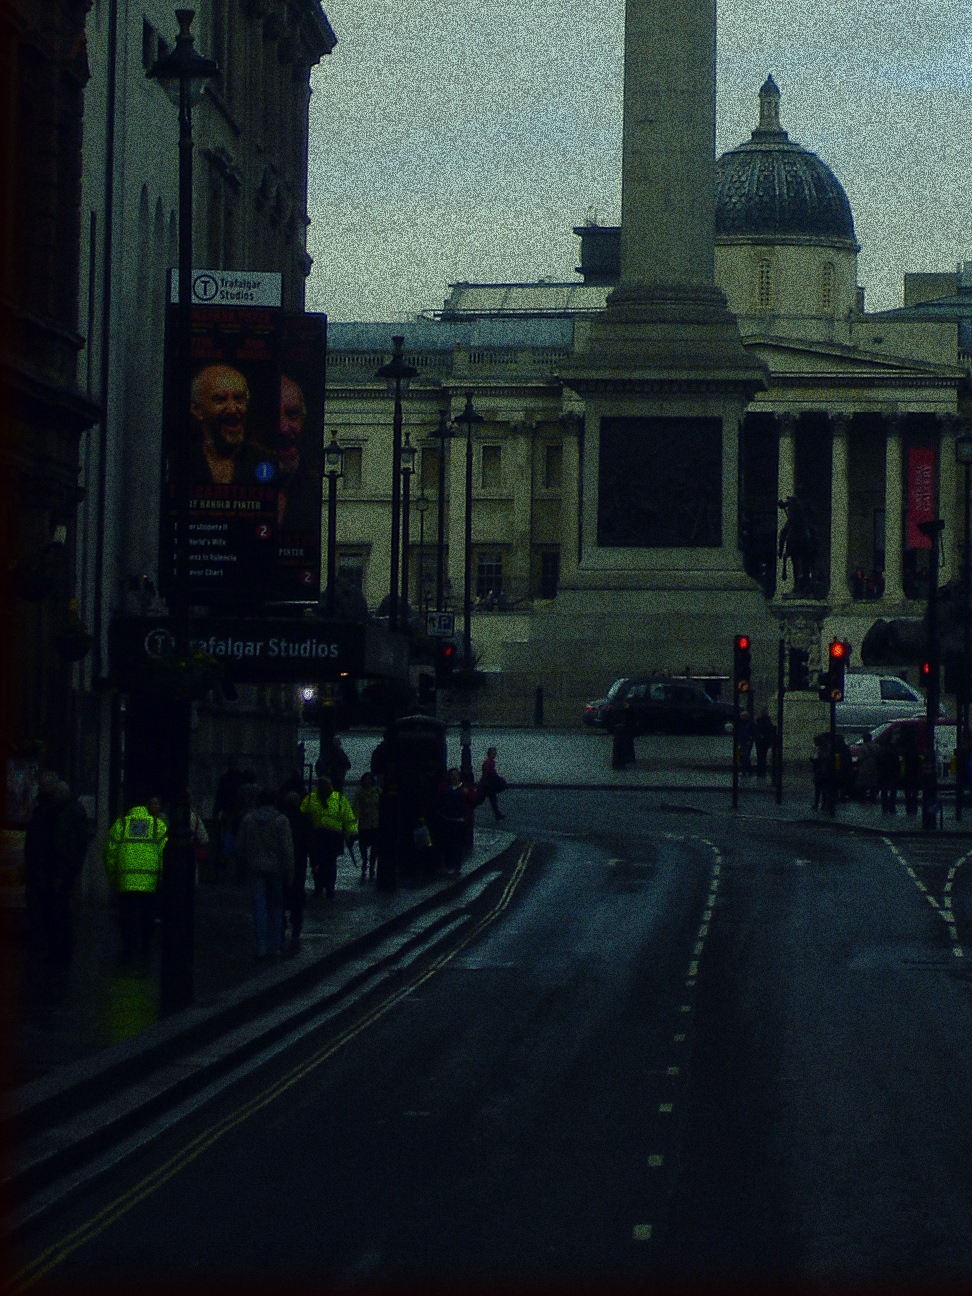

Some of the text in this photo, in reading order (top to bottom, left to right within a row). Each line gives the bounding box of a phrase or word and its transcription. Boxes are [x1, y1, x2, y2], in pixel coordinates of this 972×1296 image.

[220, 277, 261, 290] Trafalgar
[220, 290, 254, 301] Studios
[200, 499, 231, 510] HAROLD
[232, 500, 262, 511] PINTER
[260, 524, 268, 537] 2
[304, 570, 312, 583] 2
[189, 636, 340, 661] rafalgar Studios
